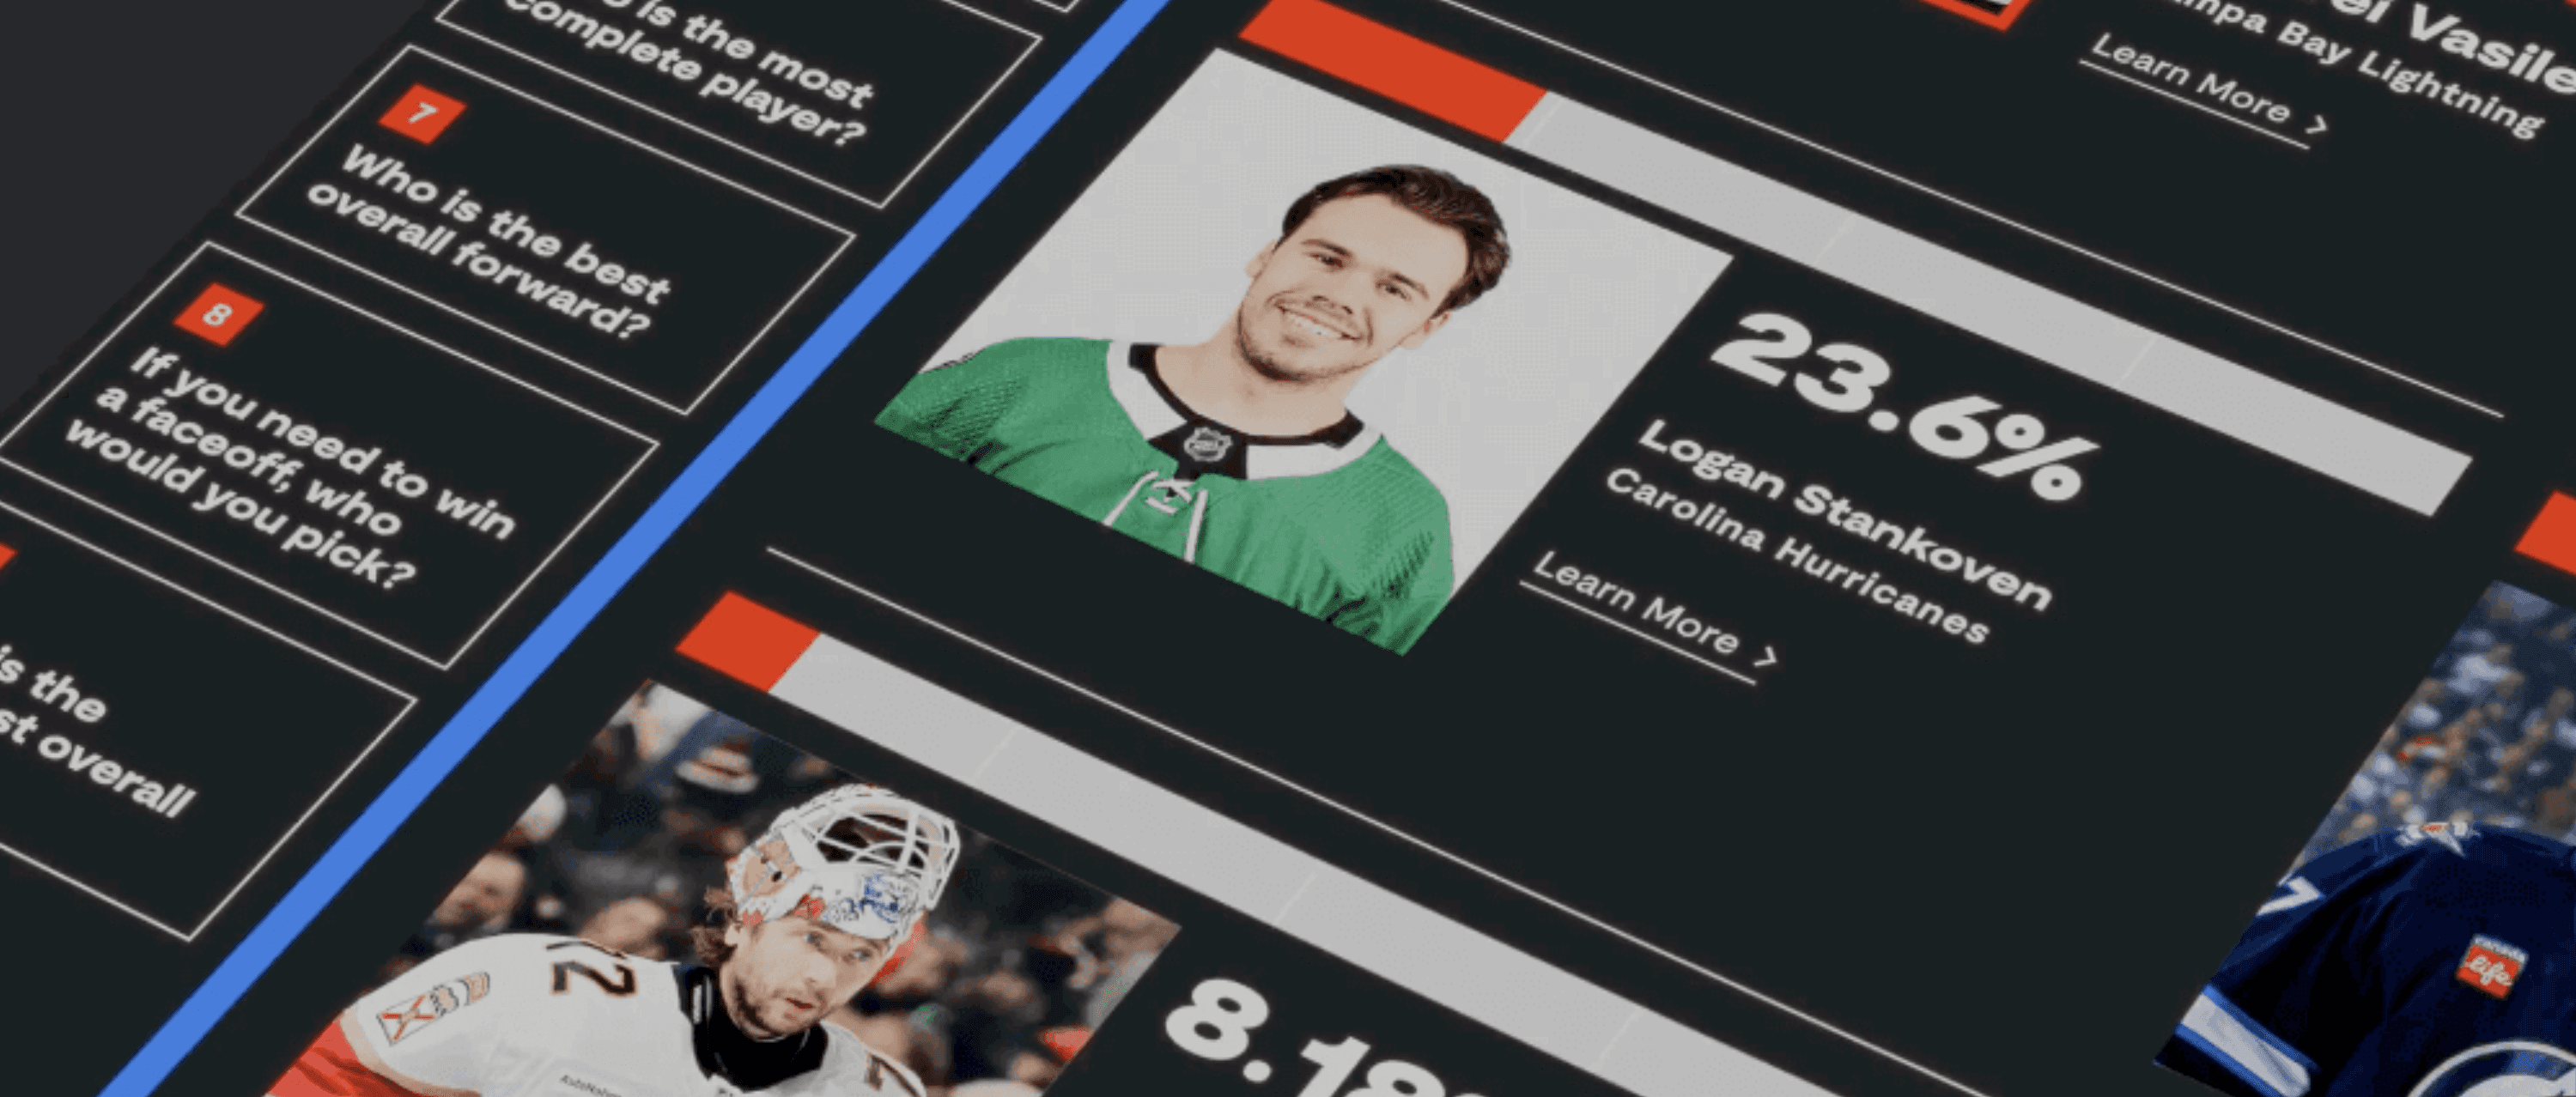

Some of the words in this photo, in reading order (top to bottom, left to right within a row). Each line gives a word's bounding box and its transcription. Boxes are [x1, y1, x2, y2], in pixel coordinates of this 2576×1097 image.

[408, 101, 439, 124] 7
[683, 15, 756, 60] the
[757, 50, 874, 110] most
[698, 72, 867, 147] player?
[2092, 32, 2190, 86] Learn
[2196, 72, 2291, 123] More
[2277, 20, 2353, 65] Bay
[2358, 50, 2546, 140] Lightning
[307, 181, 458, 256] overall
[452, 241, 652, 339] forward?
[342, 142, 439, 203] Who
[440, 188, 483, 222] is
[488, 209, 562, 258] the
[563, 242, 671, 306] best
[202, 302, 234, 328] 8
[95, 387, 129, 413] a
[131, 396, 305, 494] faceoff,
[305, 478, 403, 536] who
[130, 346, 179, 379] If
[162, 368, 258, 421] you
[256, 409, 382, 476] need
[380, 460, 428, 499] to
[435, 488, 516, 540] win
[1710, 312, 2101, 501] 23.6%
[65, 418, 207, 494] would
[191, 482, 289, 536] you
[280, 524, 416, 590] pick?
[1607, 467, 1766, 552] Carolina
[1774, 536, 1990, 644] Hurricanes
[1638, 419, 1786, 500] Logan
[1793, 484, 2053, 612] Stankoven
[1534, 550, 1637, 612] Learn
[1641, 596, 1740, 655] More
[29, 670, 107, 724] the
[38, 734, 197, 819] overall
[1164, 978, 1484, 1097] 8.1
